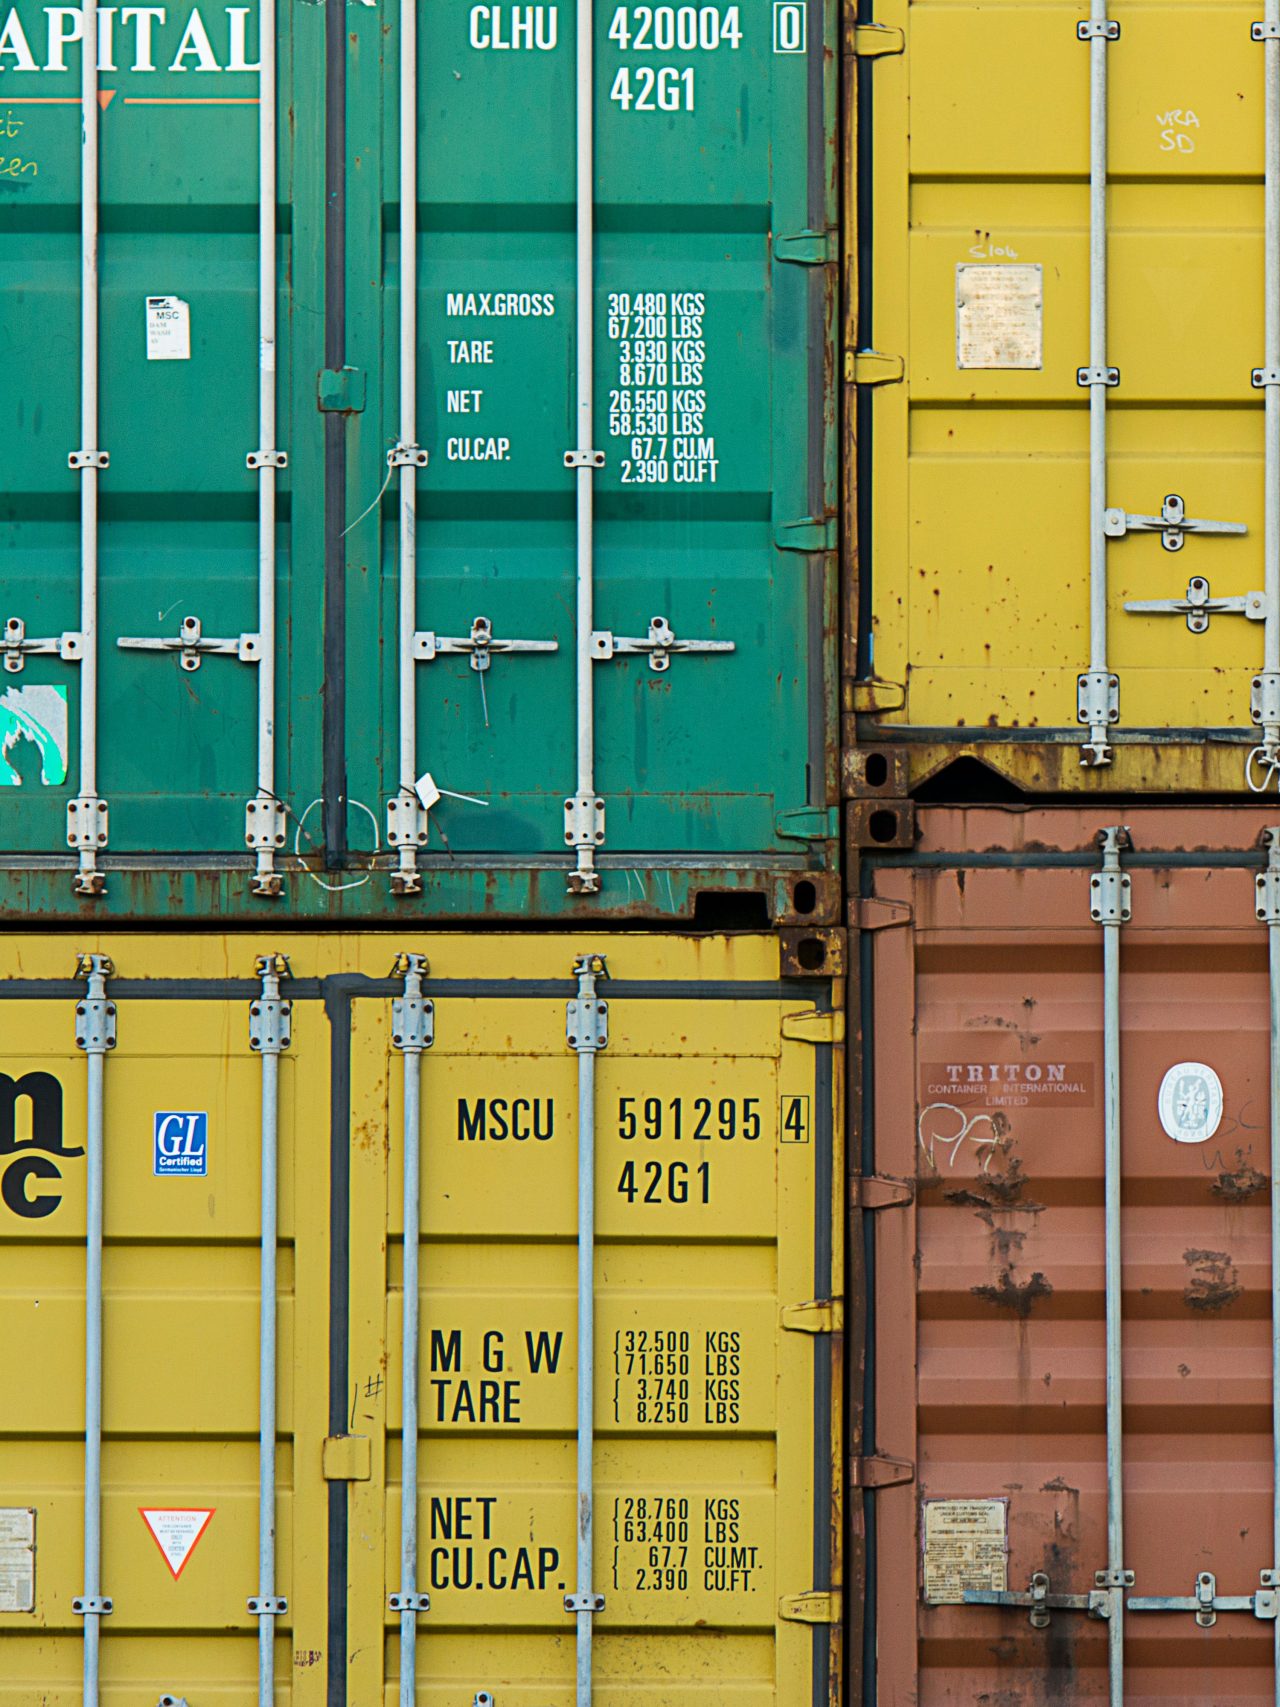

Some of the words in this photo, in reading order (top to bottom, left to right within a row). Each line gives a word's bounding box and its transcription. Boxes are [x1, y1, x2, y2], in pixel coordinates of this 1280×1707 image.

[470, 5, 557, 50] CLHU
[608, 6, 743, 50] 420004
[779, 6, 800, 49] 0
[610, 67, 694, 111] 42G1
[671, 293, 705, 316] KGS
[671, 316, 703, 339] LBS
[447, 341, 493, 363] TARE
[672, 341, 705, 363] KGS
[672, 363, 703, 386] LBS
[447, 390, 483, 412] NET
[672, 390, 706, 412] KGS
[672, 413, 704, 435] LBS
[631, 437, 668, 460] 67.7
[672, 437, 714, 460] CU.M
[673, 460, 719, 483] CU.FT
[947, 1064, 1066, 1082] TRITON
[928, 1084, 988, 1094] CONTAINER
[1003, 1083, 1086, 1093] INTERNATIONAL
[986, 1096, 1028, 1106] LIMITED
[457, 1098, 554, 1141] MSCU
[618, 1097, 761, 1140] 591295
[785, 1098, 805, 1140] 4
[158, 1115, 204, 1156] GL
[159, 1156, 203, 1166] Certified
[617, 1161, 710, 1204] 42G1
[430, 1330, 461, 1372] M
[483, 1331, 504, 1373] G
[525, 1331, 563, 1373] W
[705, 1331, 740, 1353] KGS
[705, 1354, 740, 1376] LBS
[705, 1379, 740, 1401] KGS
[430, 1380, 521, 1423] TARE
[705, 1402, 740, 1423] LBS
[430, 1497, 497, 1540] NET
[705, 1498, 740, 1520] KGS
[705, 1522, 739, 1543] LBS
[649, 1547, 688, 1568] 67.7
